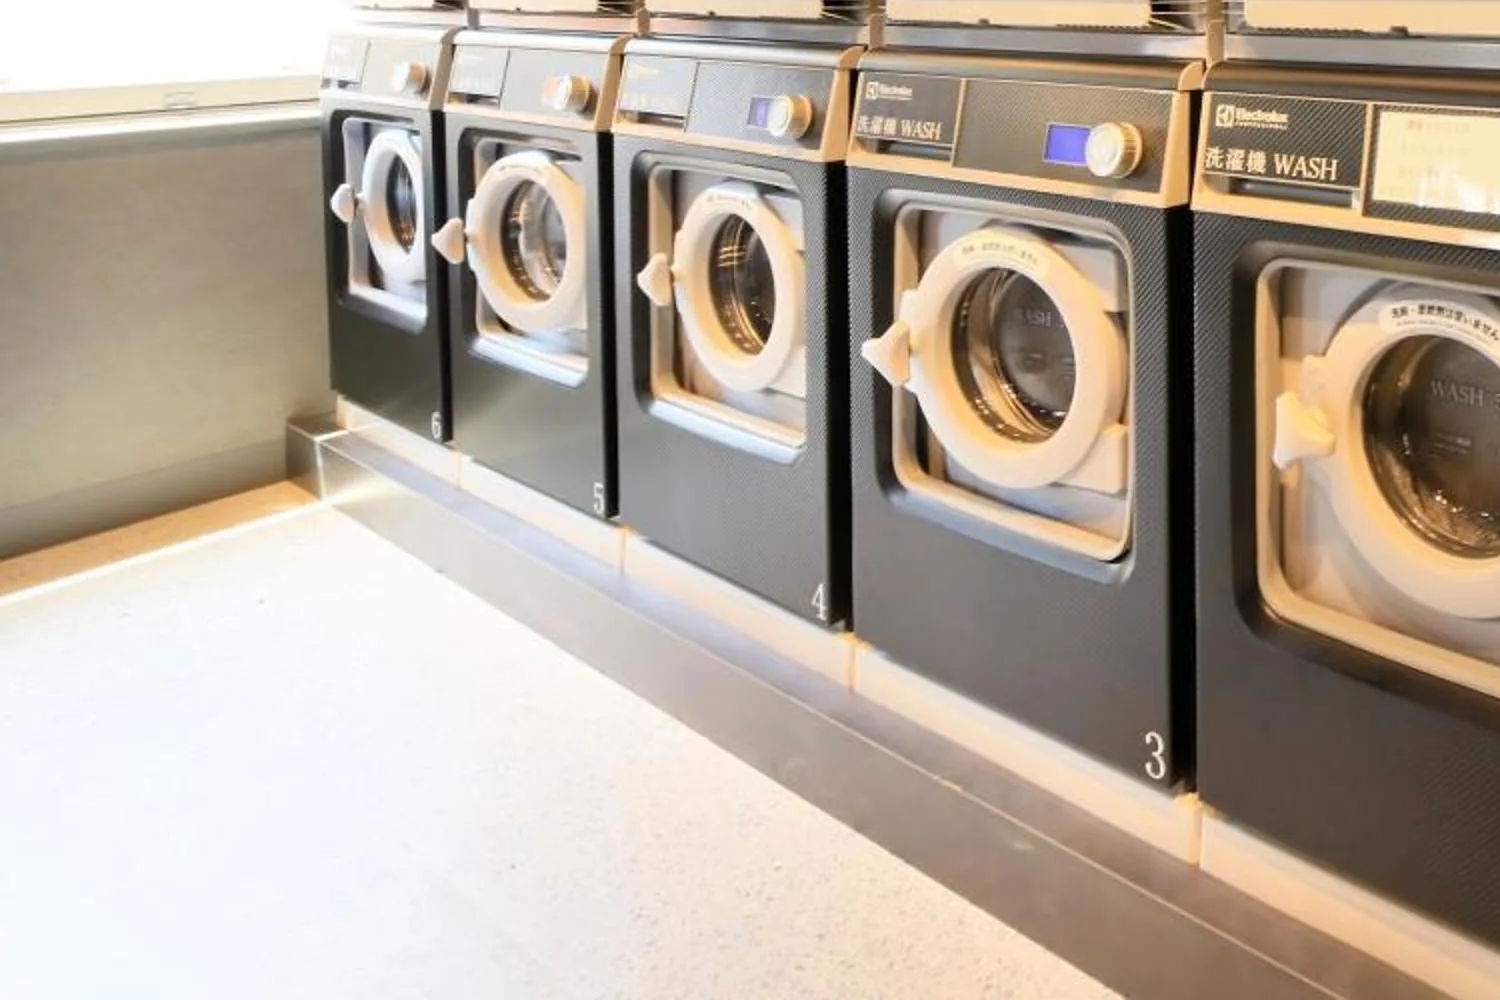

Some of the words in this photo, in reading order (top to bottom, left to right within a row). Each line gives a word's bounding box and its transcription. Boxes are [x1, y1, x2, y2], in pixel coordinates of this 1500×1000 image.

[901, 119, 943, 141] WASH
[1274, 153, 1339, 181] WASH
[1430, 379, 1484, 408] WASH
[431, 411, 442, 439] 6
[593, 481, 604, 515] 5
[811, 583, 828, 621] 4
[1145, 731, 1166, 779] 3
